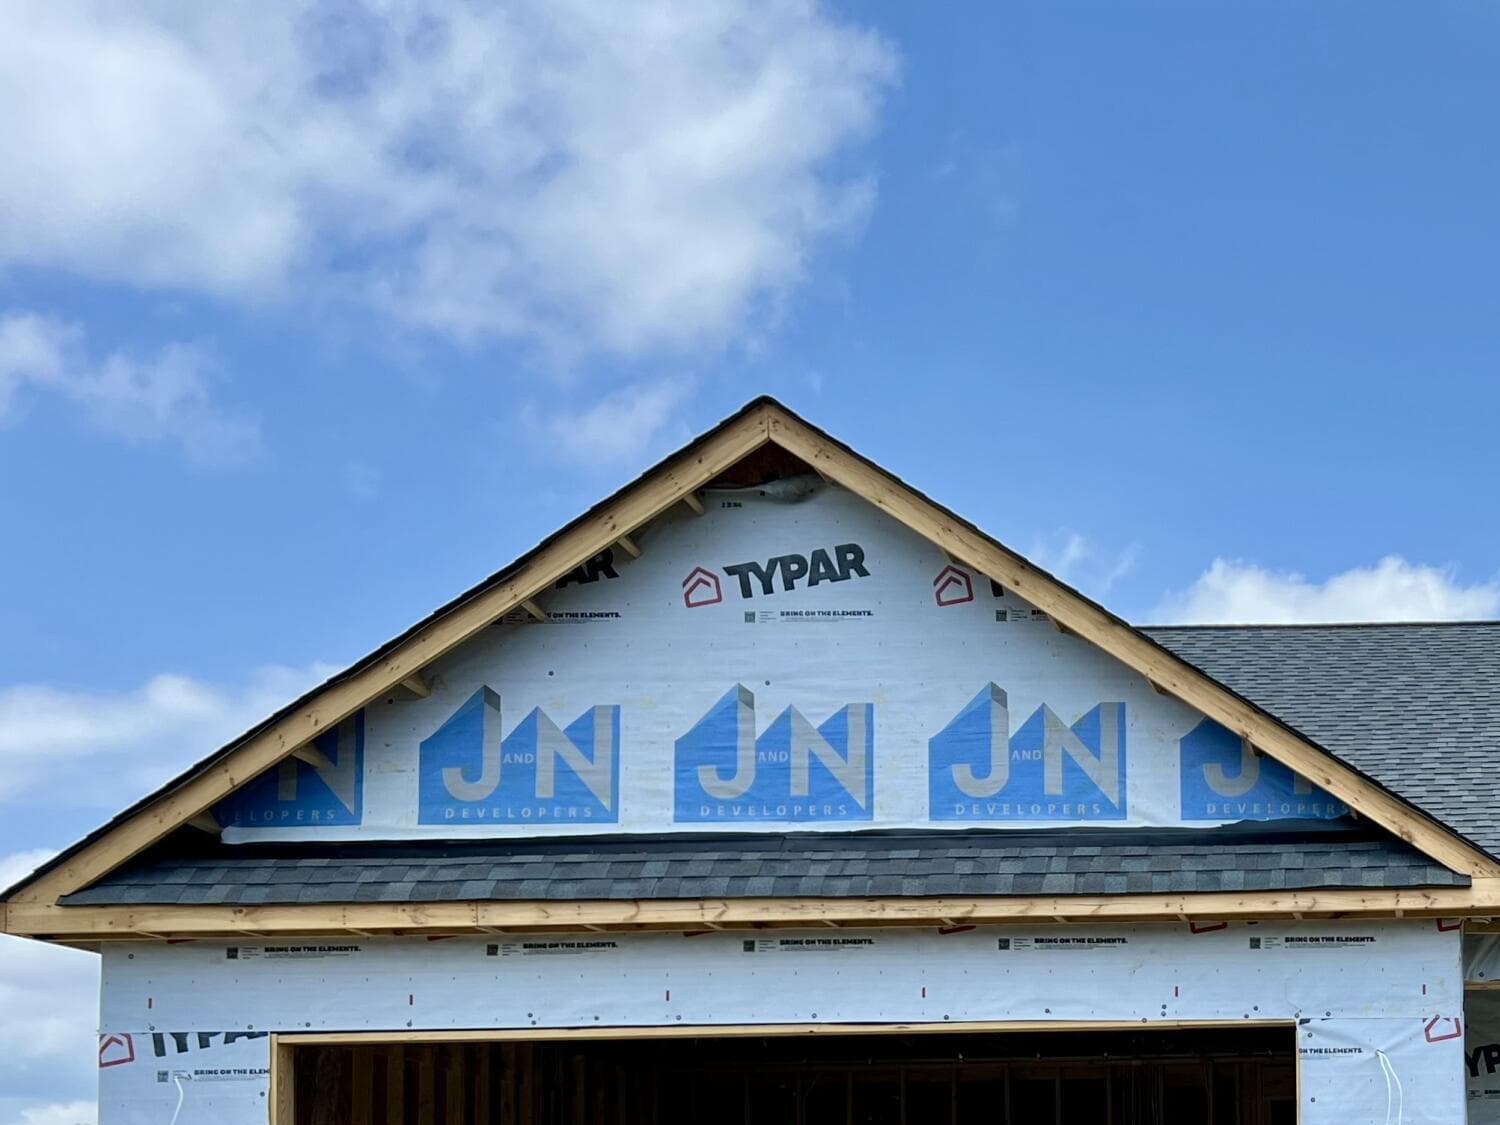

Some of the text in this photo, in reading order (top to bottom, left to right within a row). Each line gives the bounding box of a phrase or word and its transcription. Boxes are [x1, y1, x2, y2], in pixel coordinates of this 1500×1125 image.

[723, 543, 871, 599] TYPAR
[442, 684, 612, 813] J AND N
[698, 683, 866, 810] J AND N
[952, 681, 1120, 810] J AND N
[444, 806, 593, 819] DEVELOPERS
[700, 805, 847, 817] DEVELOPERS
[955, 803, 1101, 816] DEVELOPERS
